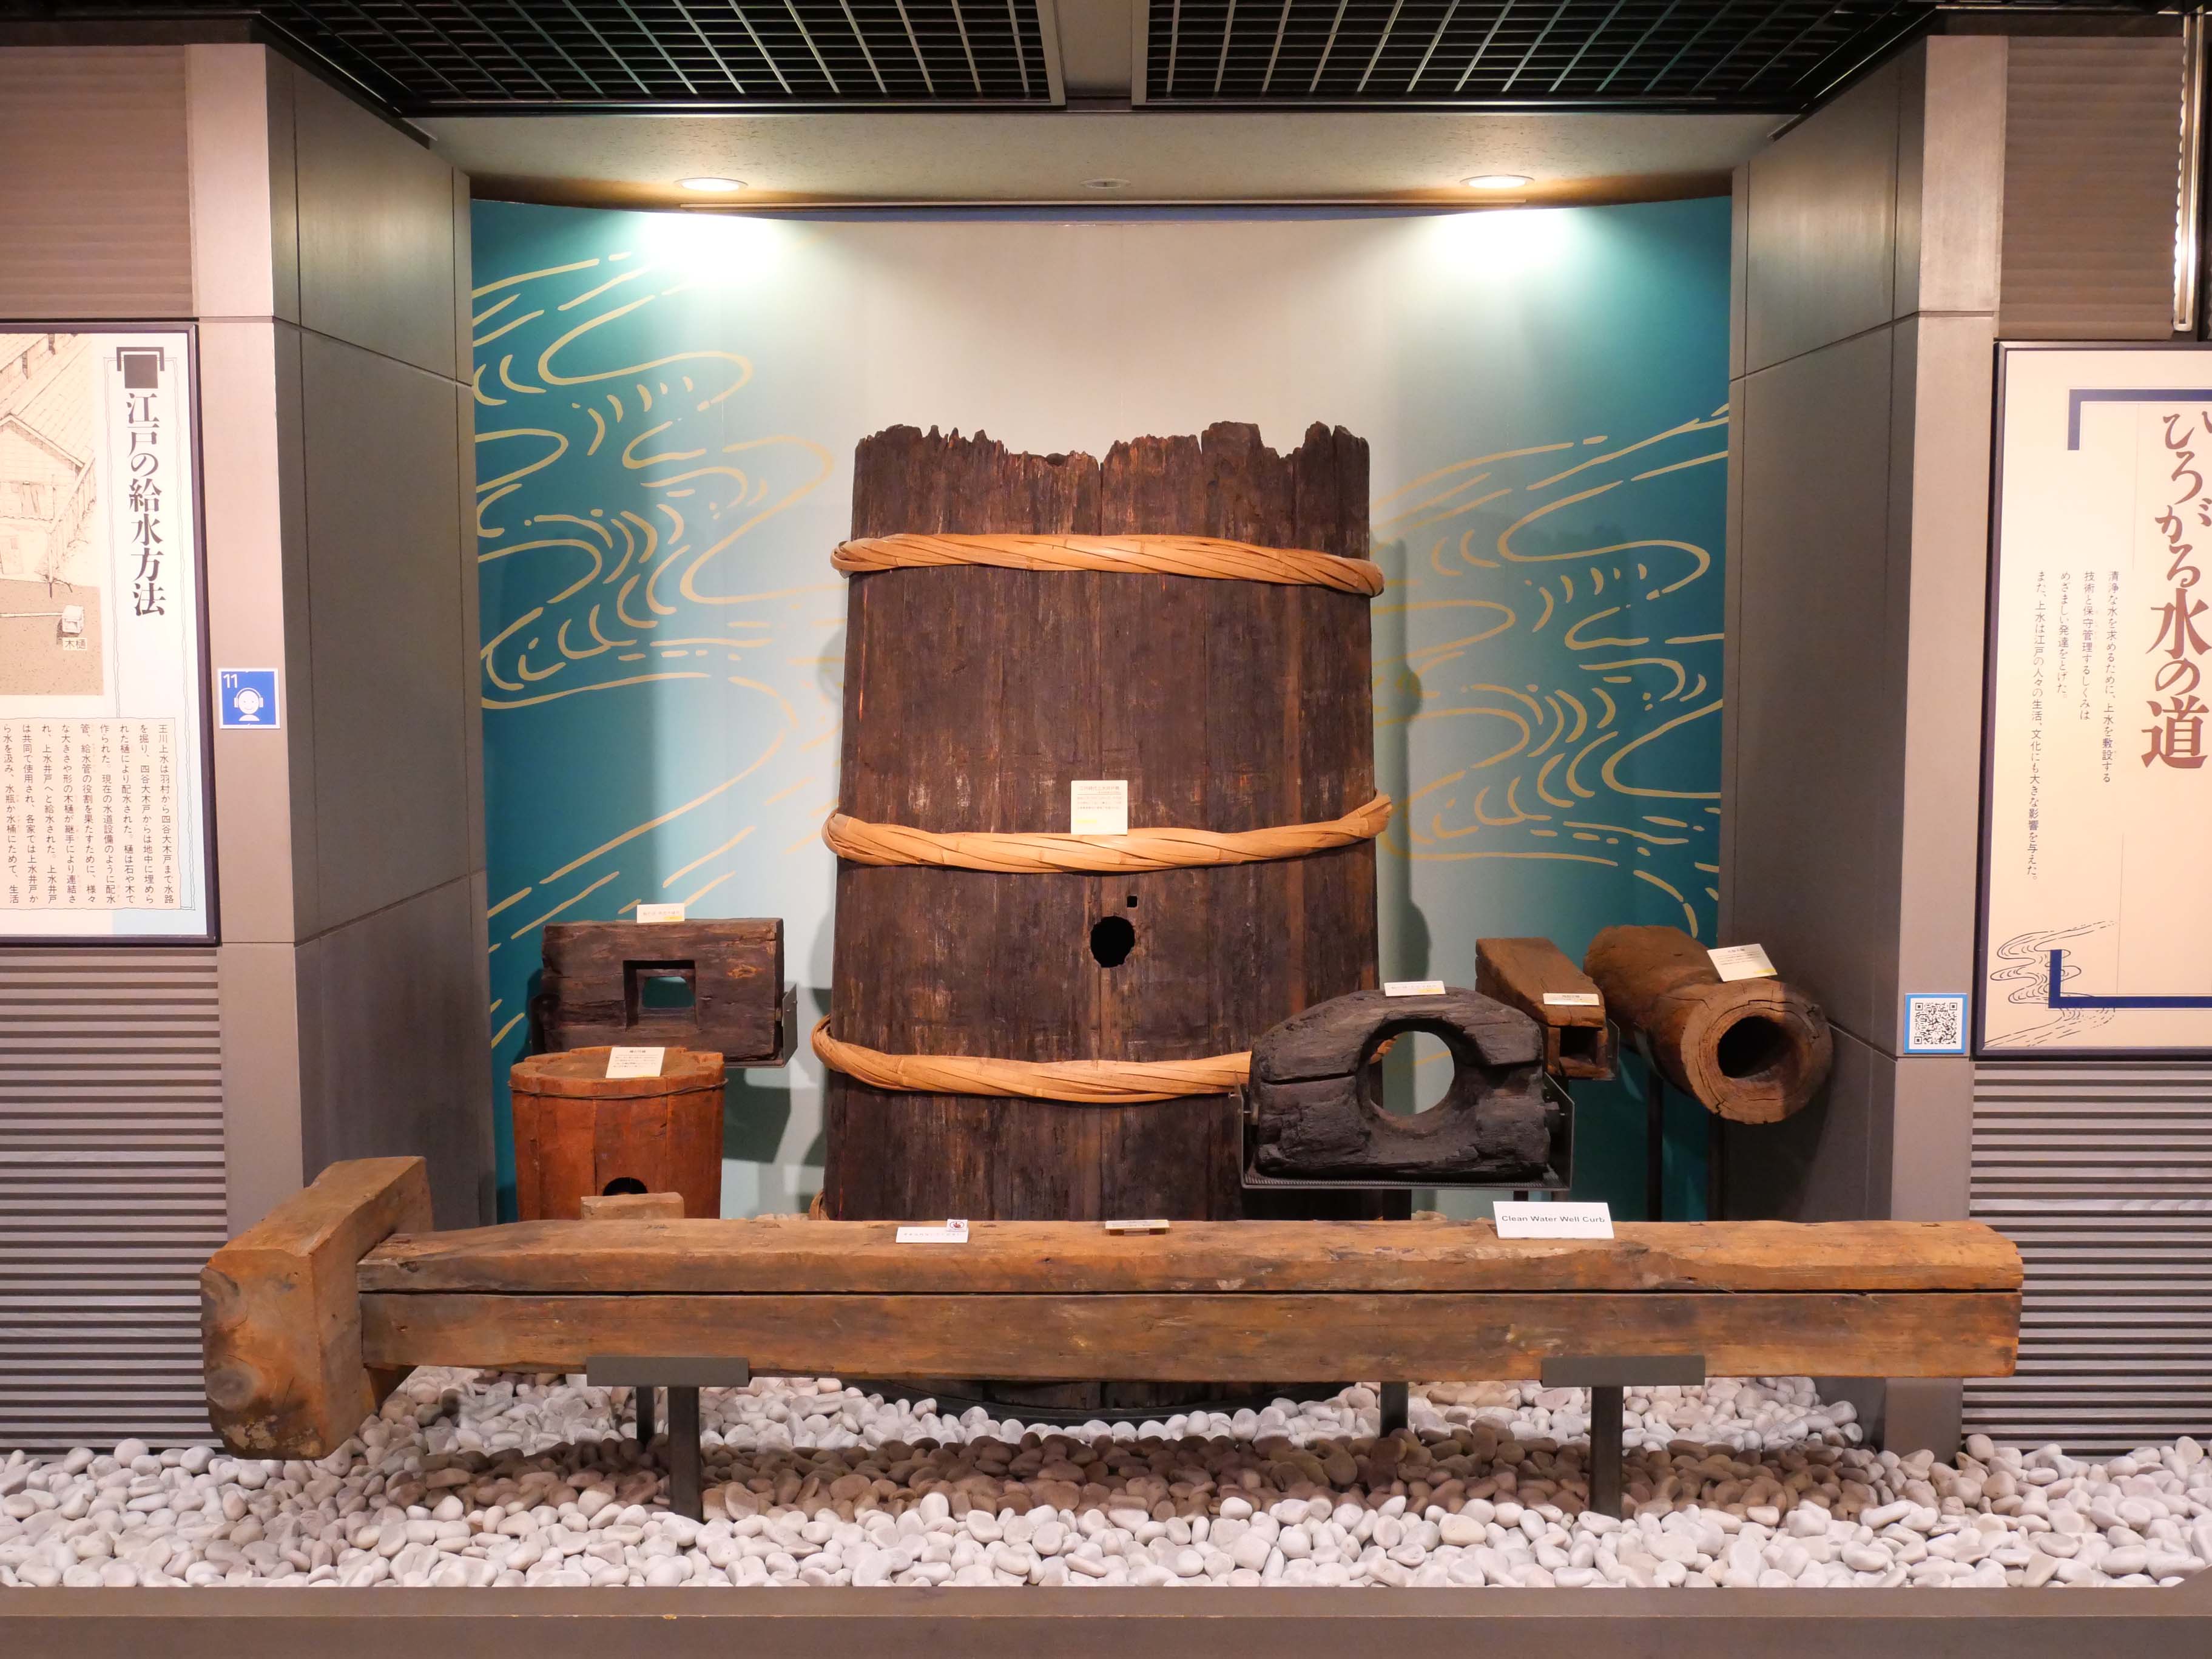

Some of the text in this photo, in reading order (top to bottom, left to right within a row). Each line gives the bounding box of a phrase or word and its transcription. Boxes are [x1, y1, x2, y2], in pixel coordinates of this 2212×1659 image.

[126, 393, 166, 617] 江戸の給水方法
[2057, 572, 2071, 698] めざましい発達をとげた。
[2080, 571, 2095, 720] 技術と保守管理するしくみは
[2141, 411, 2212, 769] ひろがる水の道
[223, 674, 237, 688] 11
